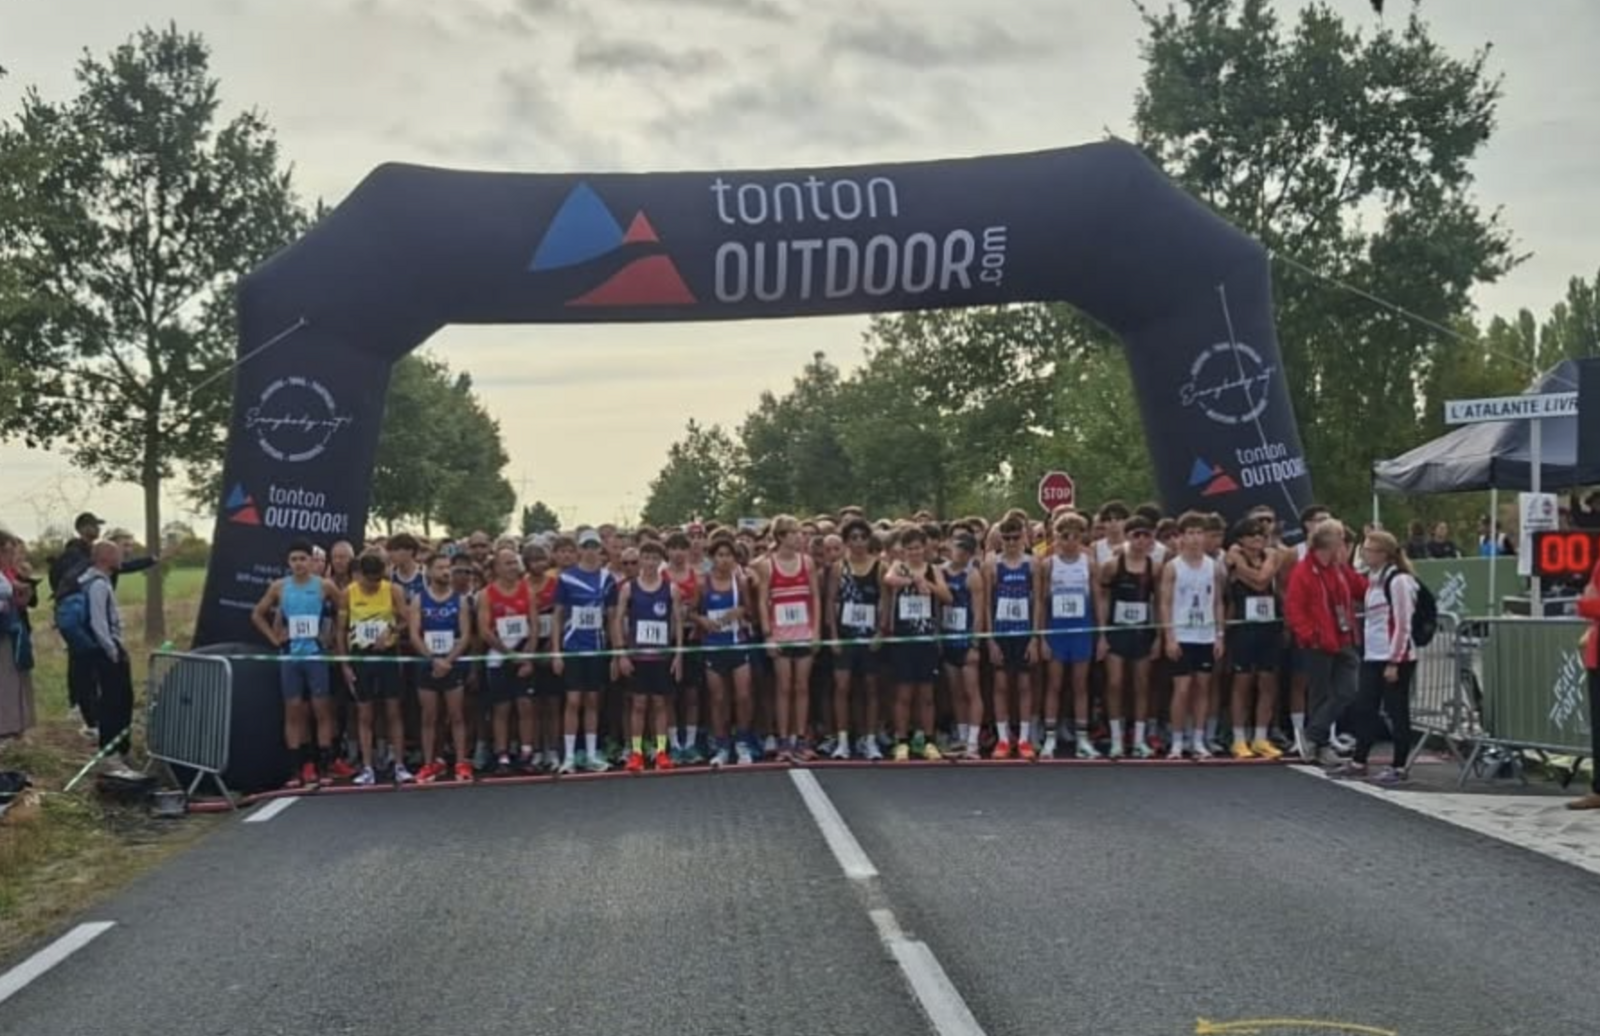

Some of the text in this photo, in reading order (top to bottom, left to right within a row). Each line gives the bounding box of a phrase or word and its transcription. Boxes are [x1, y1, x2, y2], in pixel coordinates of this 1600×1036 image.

[710, 175, 898, 224] tonton
[714, 229, 975, 302] OUTDOOR
[1451, 400, 1539, 419] L'ATALANTE
[1236, 442, 1288, 465] tonton
[268, 484, 326, 508] tonton
[1043, 487, 1071, 500] STOP
[264, 505, 342, 534] OUTDOOR
